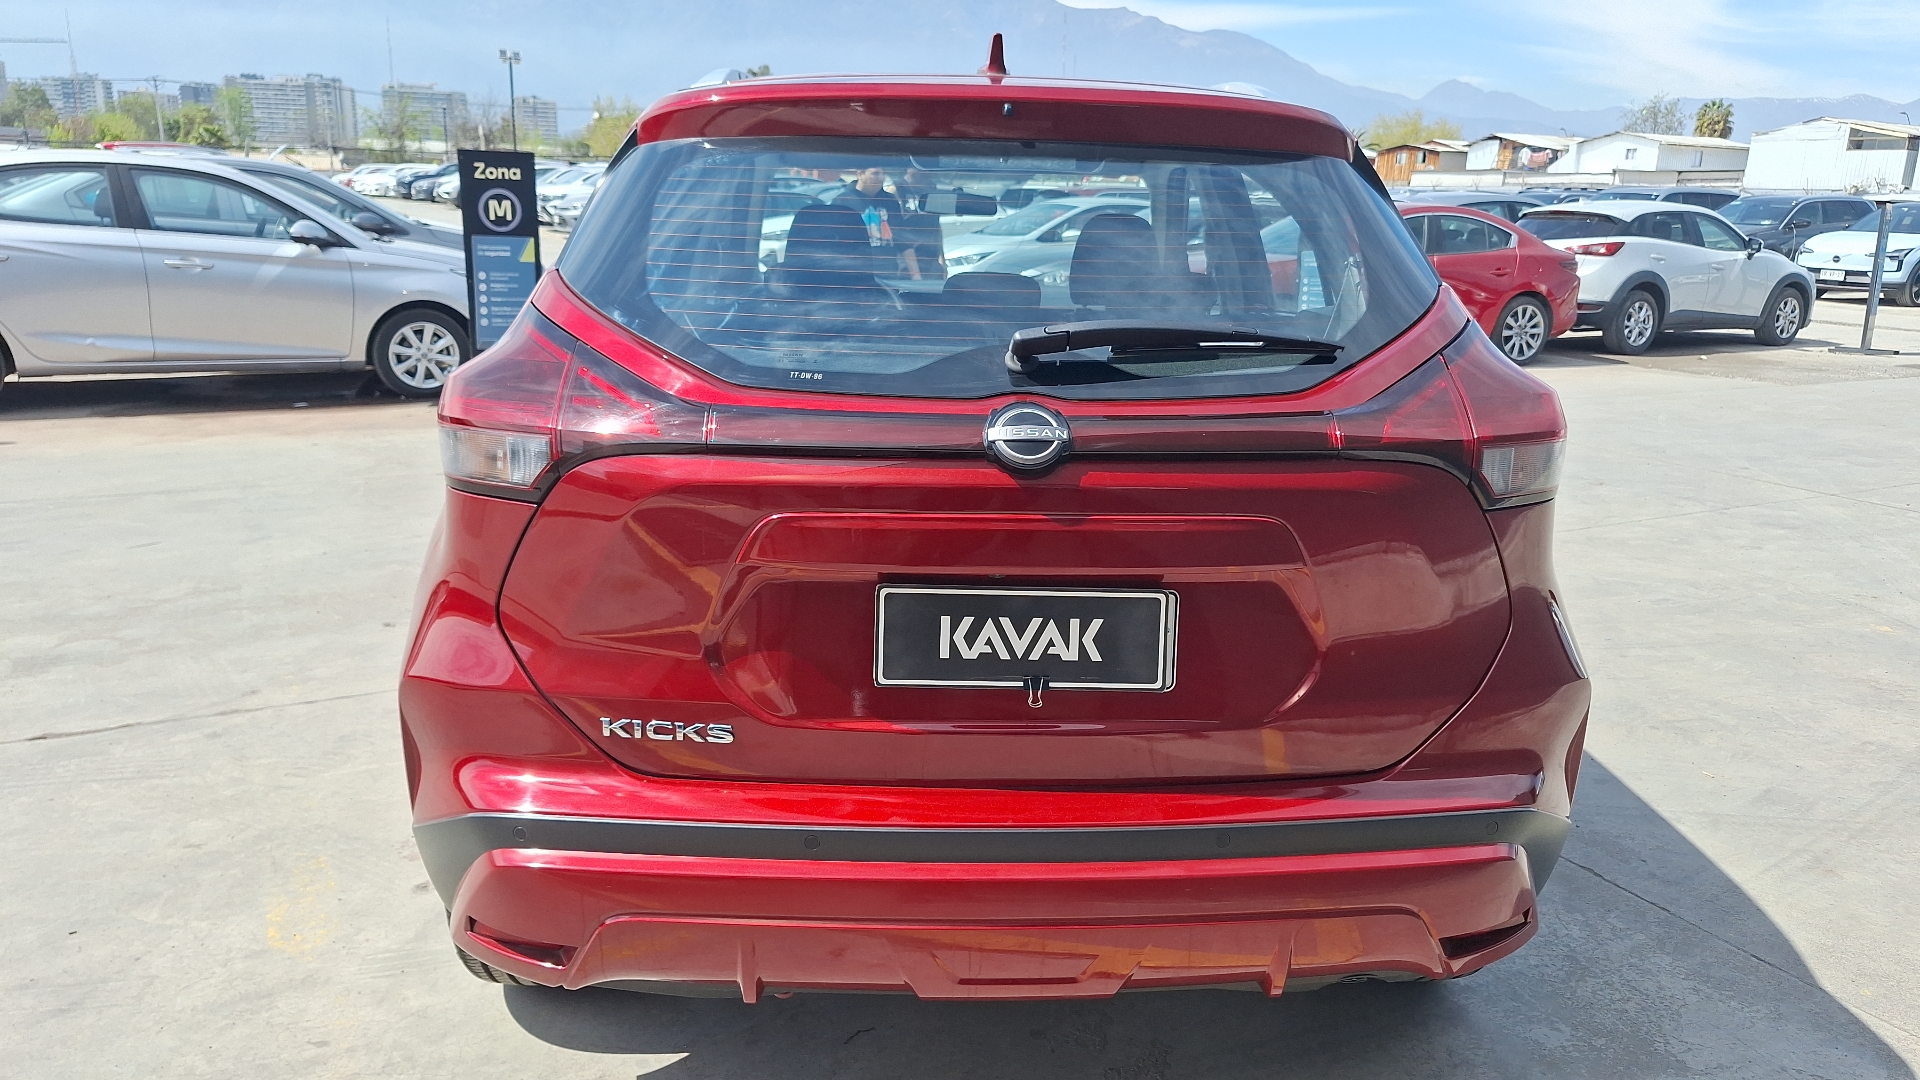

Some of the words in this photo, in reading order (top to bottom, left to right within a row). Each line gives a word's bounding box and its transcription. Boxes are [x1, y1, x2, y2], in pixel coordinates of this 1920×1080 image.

[473, 161, 521, 180] Zona
[488, 199, 512, 220] M
[939, 615, 1104, 662] KAVAK
[600, 717, 734, 743] KICKS
